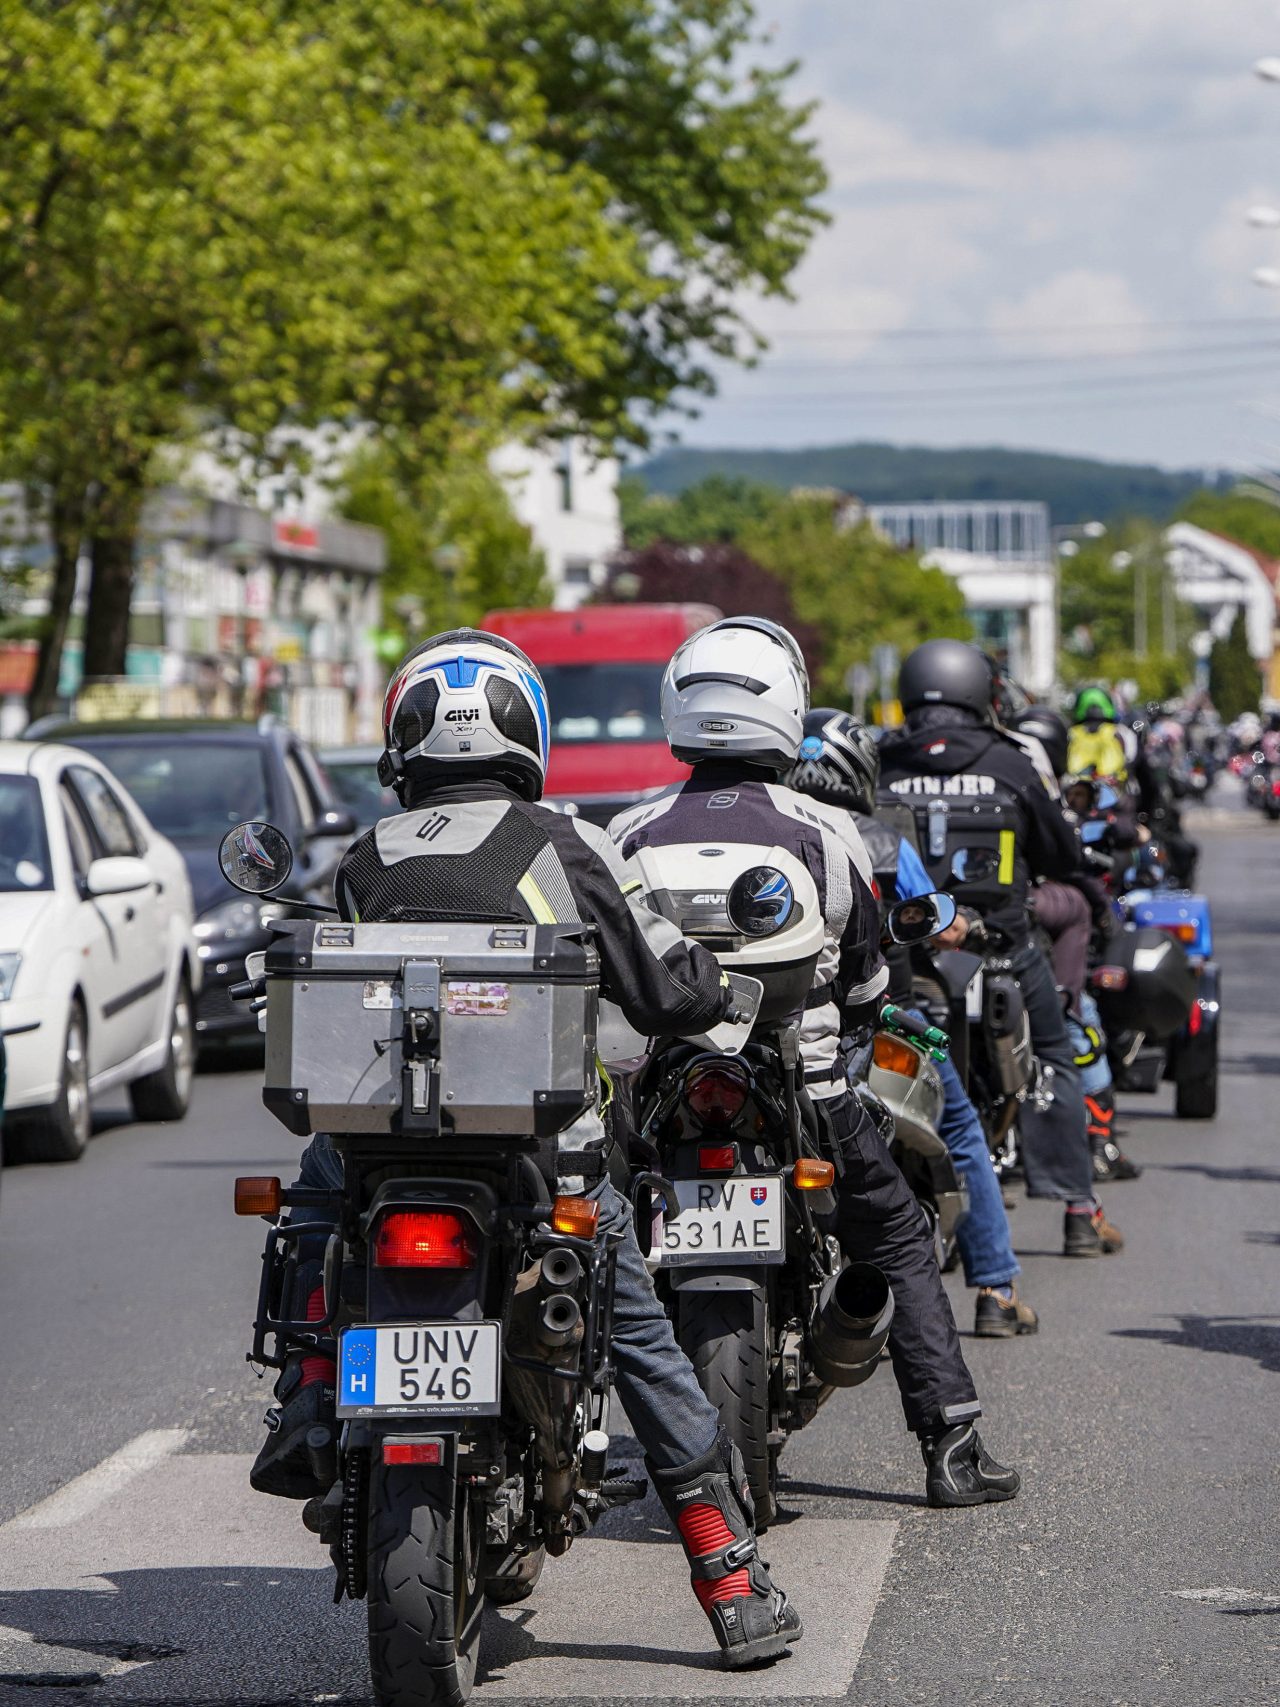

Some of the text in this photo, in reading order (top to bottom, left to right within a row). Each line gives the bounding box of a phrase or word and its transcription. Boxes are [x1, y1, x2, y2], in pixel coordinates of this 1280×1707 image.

[444, 709, 480, 722] GIVI
[698, 1184, 736, 1212] RV
[664, 1219, 770, 1249] 531AE
[394, 1329, 478, 1364] UNV
[351, 1374, 367, 1392] H
[400, 1366, 471, 1401] 546
